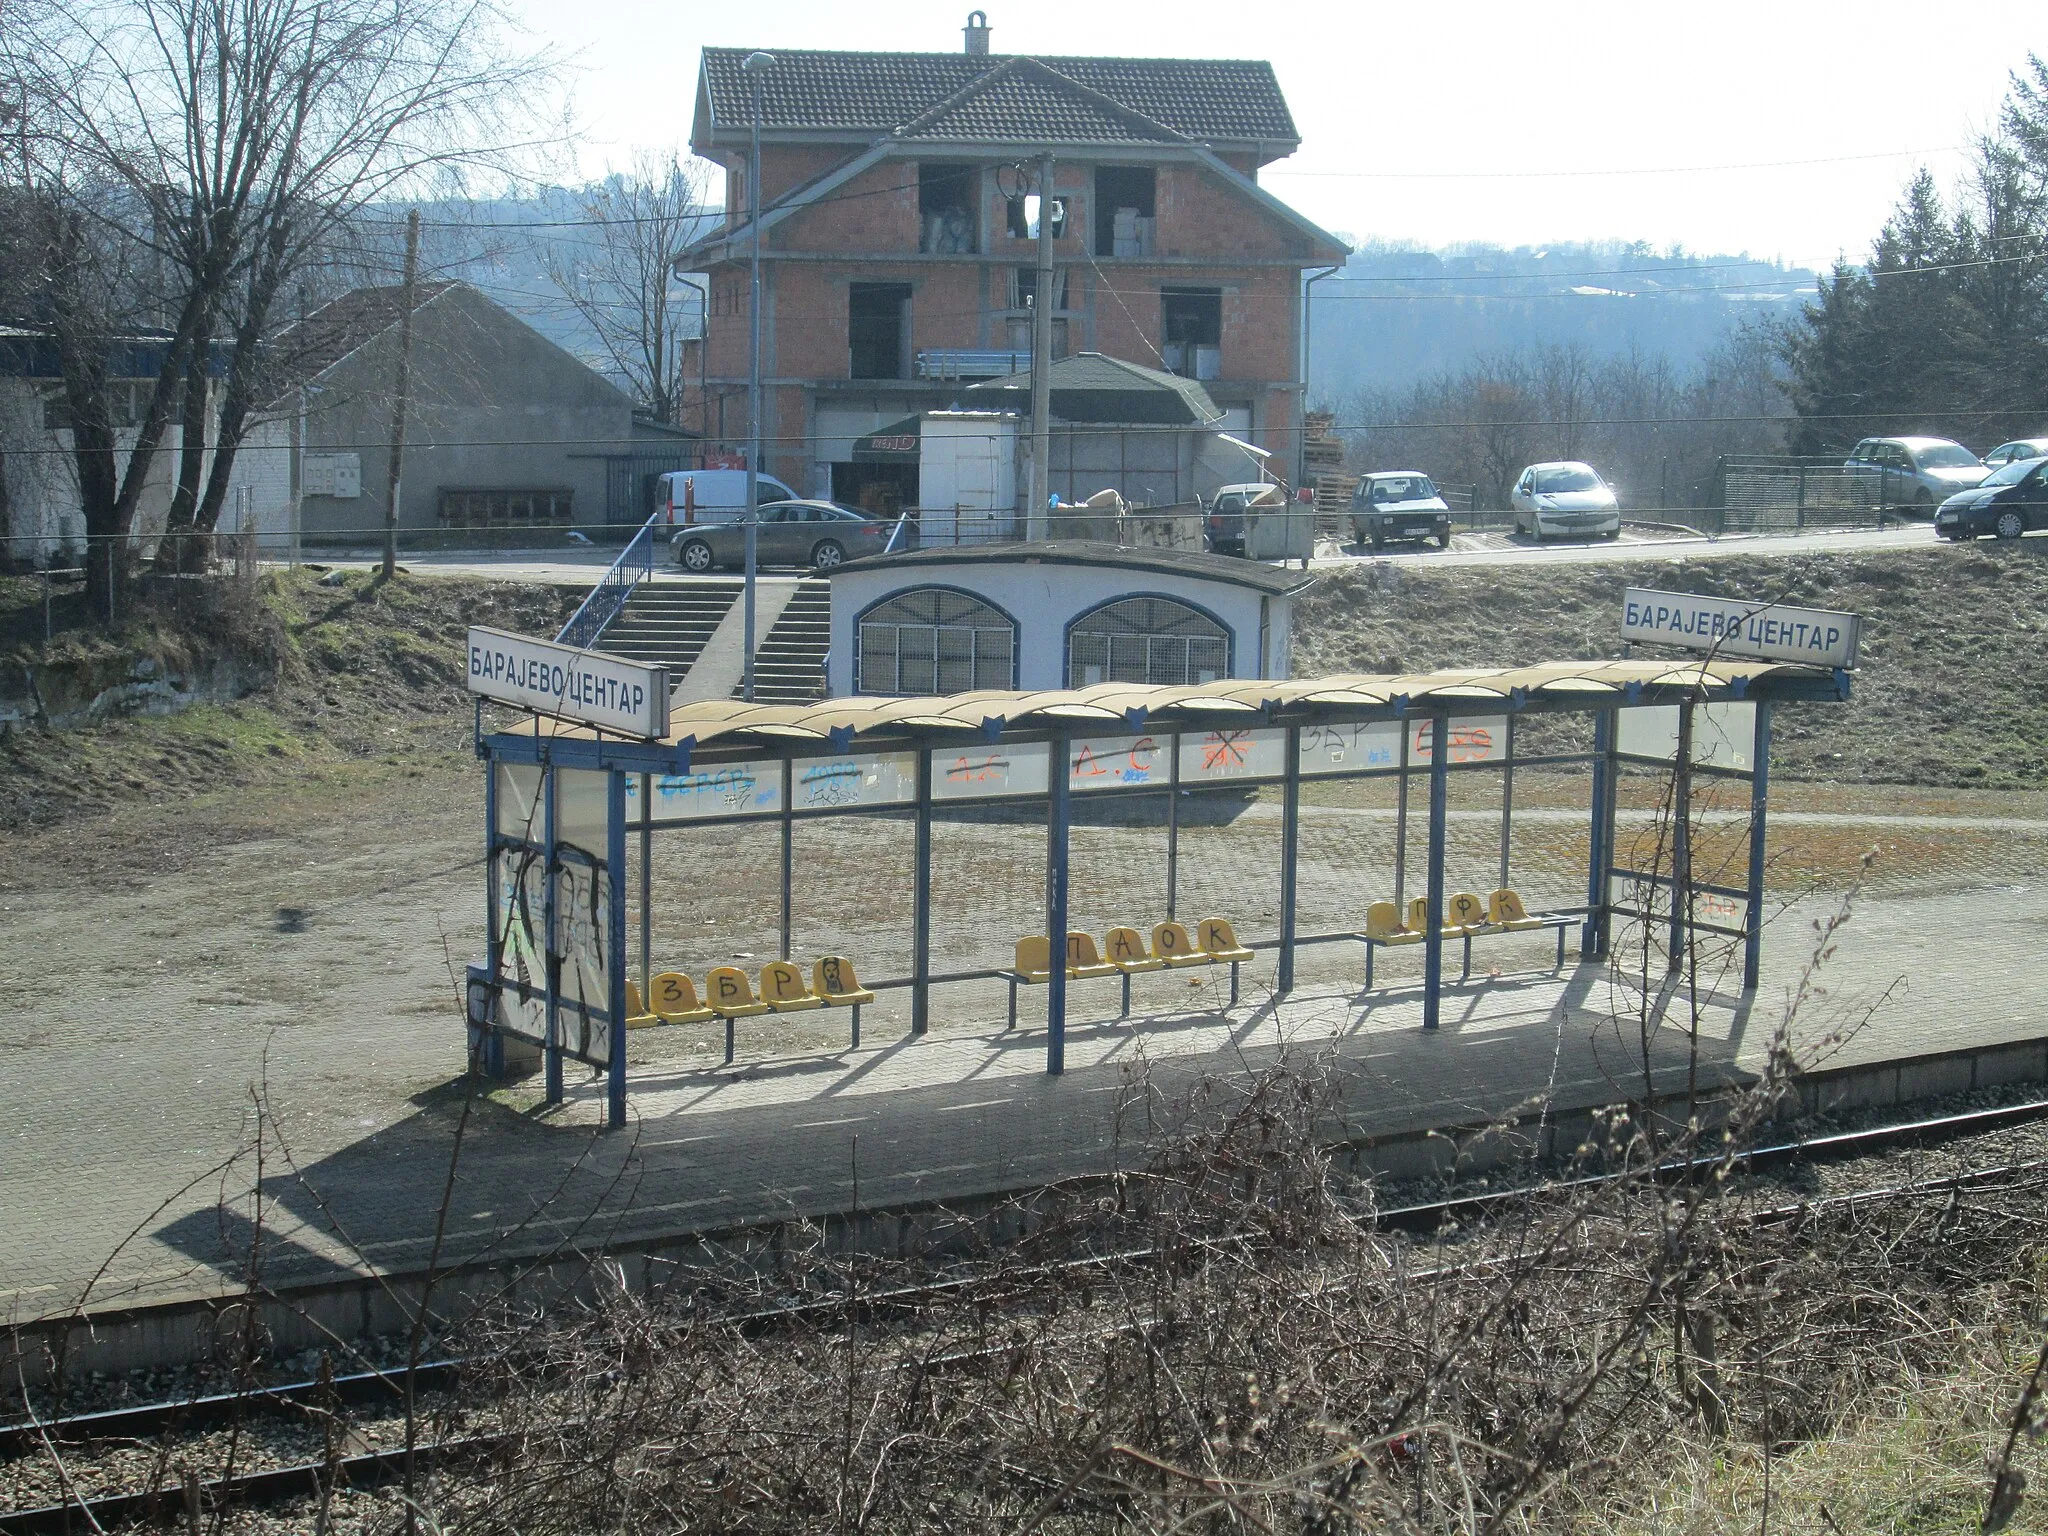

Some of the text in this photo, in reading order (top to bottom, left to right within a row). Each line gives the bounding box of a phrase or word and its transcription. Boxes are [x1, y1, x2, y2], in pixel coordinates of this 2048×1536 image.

[1625, 602, 1840, 651] БАРАЈЕВО ЦЕНТАР
[470, 646, 644, 715] БАРАЈЕВО ЦЕНТАР
